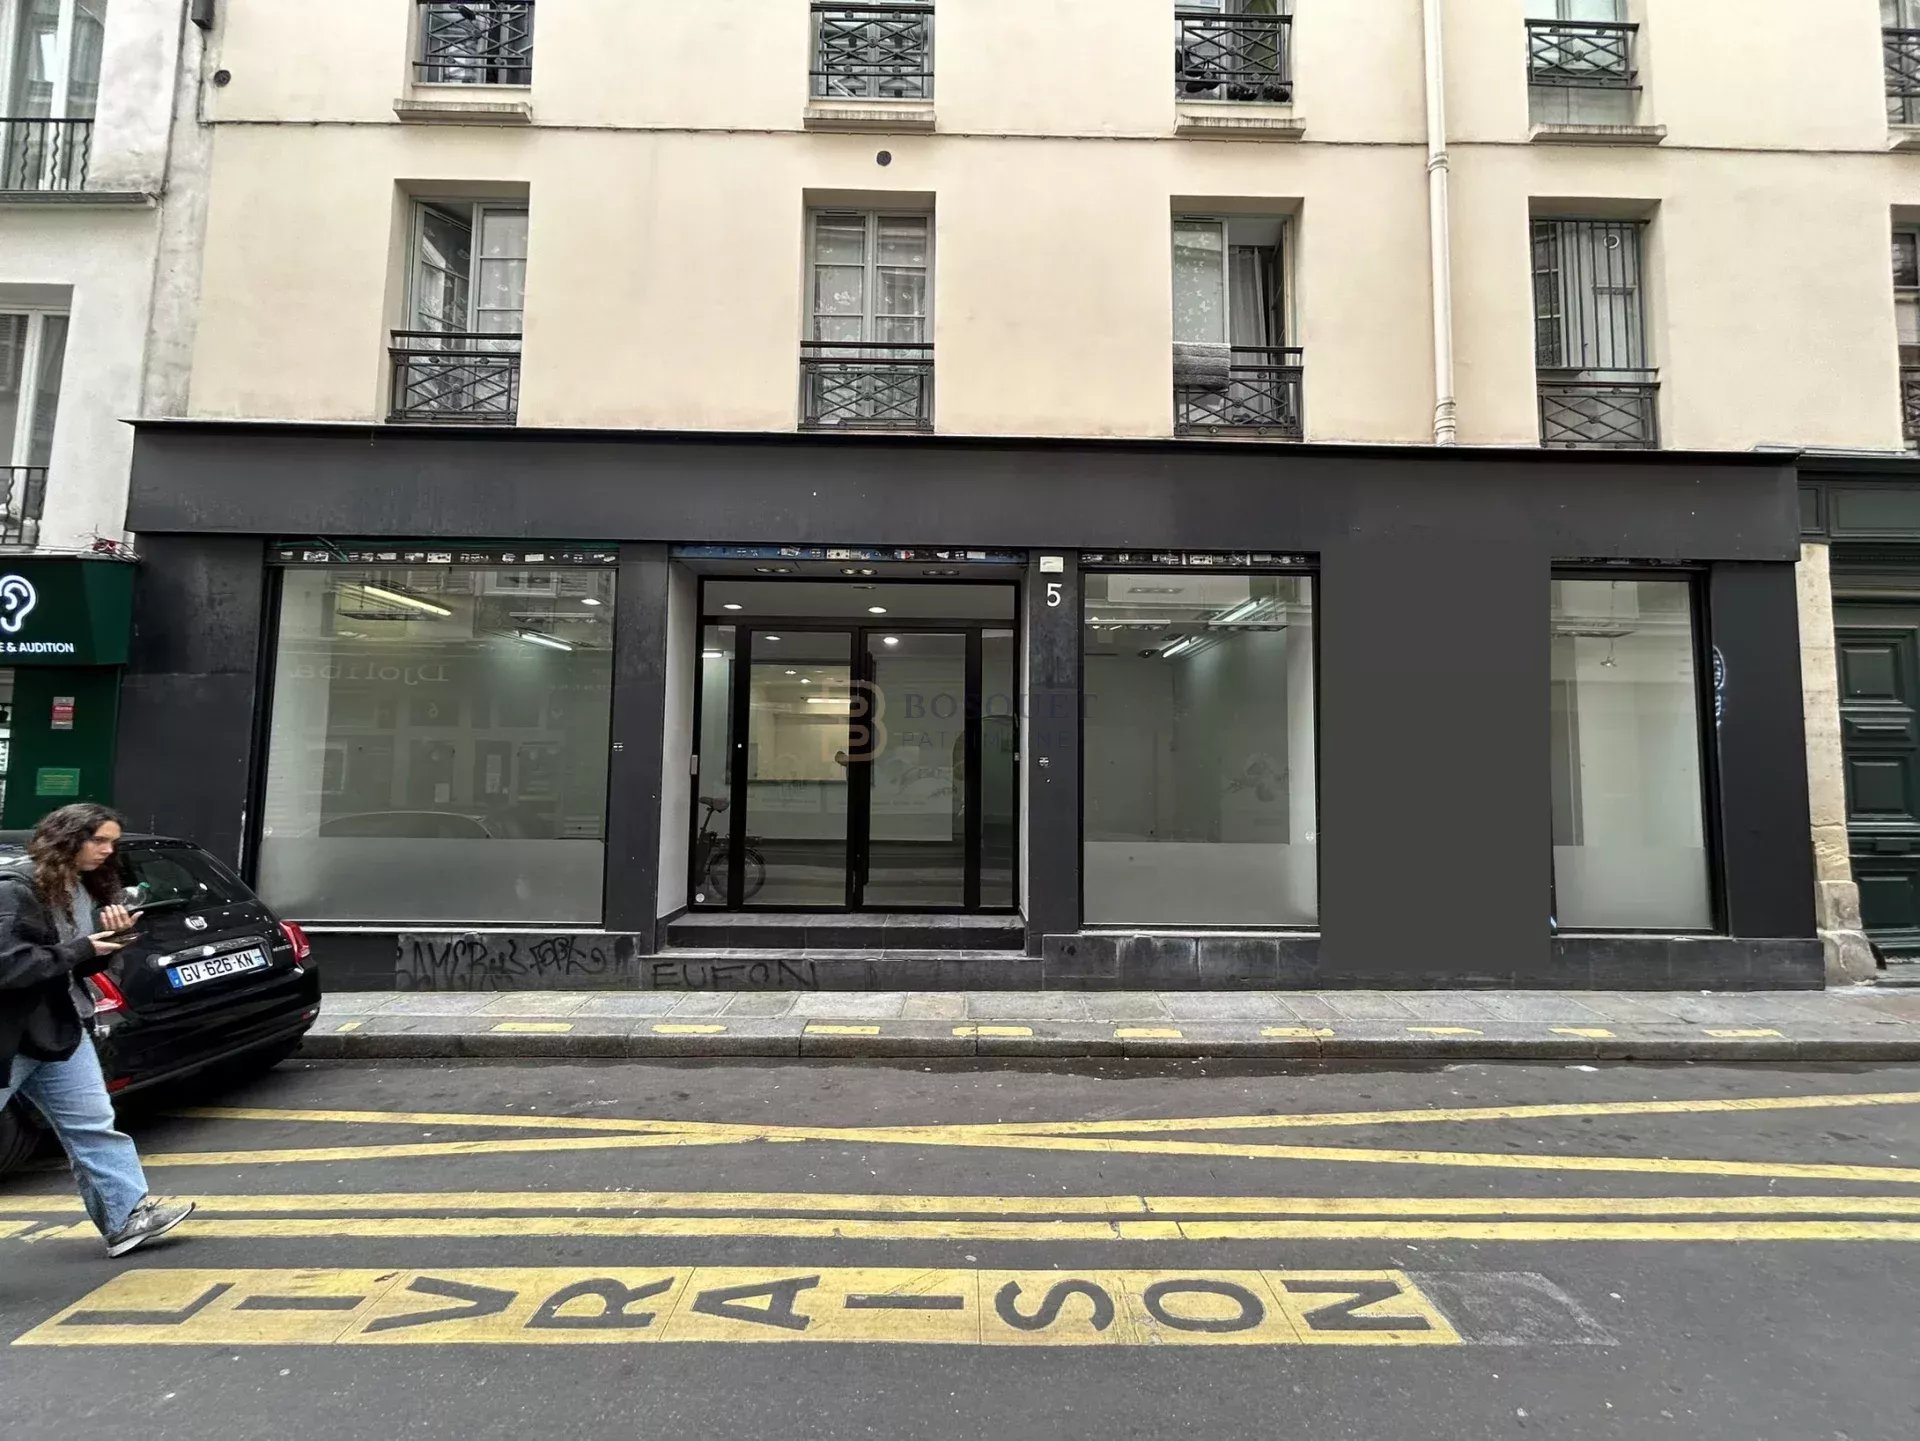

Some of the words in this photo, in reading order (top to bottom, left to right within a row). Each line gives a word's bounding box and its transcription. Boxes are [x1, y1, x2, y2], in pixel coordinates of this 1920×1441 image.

[1047, 583, 1062, 607] 5
[6, 642, 17, 652] &
[19, 642, 74, 652] AUDITION
[181, 951, 255, 983] GV-626-KN
[57, 1275, 1432, 1334] LIVRAISON
